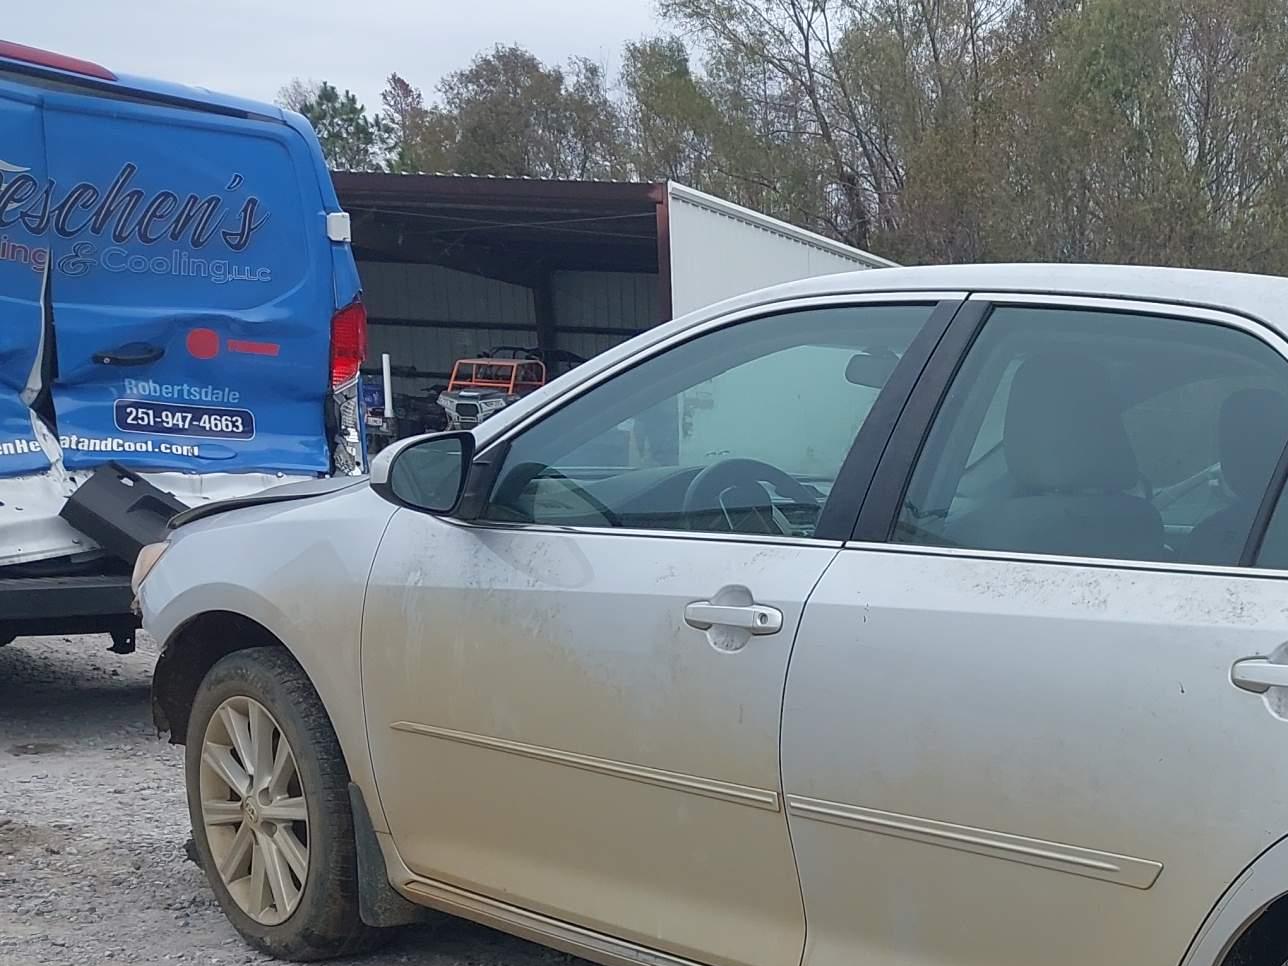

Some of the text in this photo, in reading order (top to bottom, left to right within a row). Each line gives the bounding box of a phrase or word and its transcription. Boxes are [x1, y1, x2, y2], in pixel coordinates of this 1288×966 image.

[0, 162, 271, 252] eschen's
[57, 241, 97, 277] &
[124, 378, 240, 403] Robertsdale
[126, 407, 243, 433] 251-947-4663
